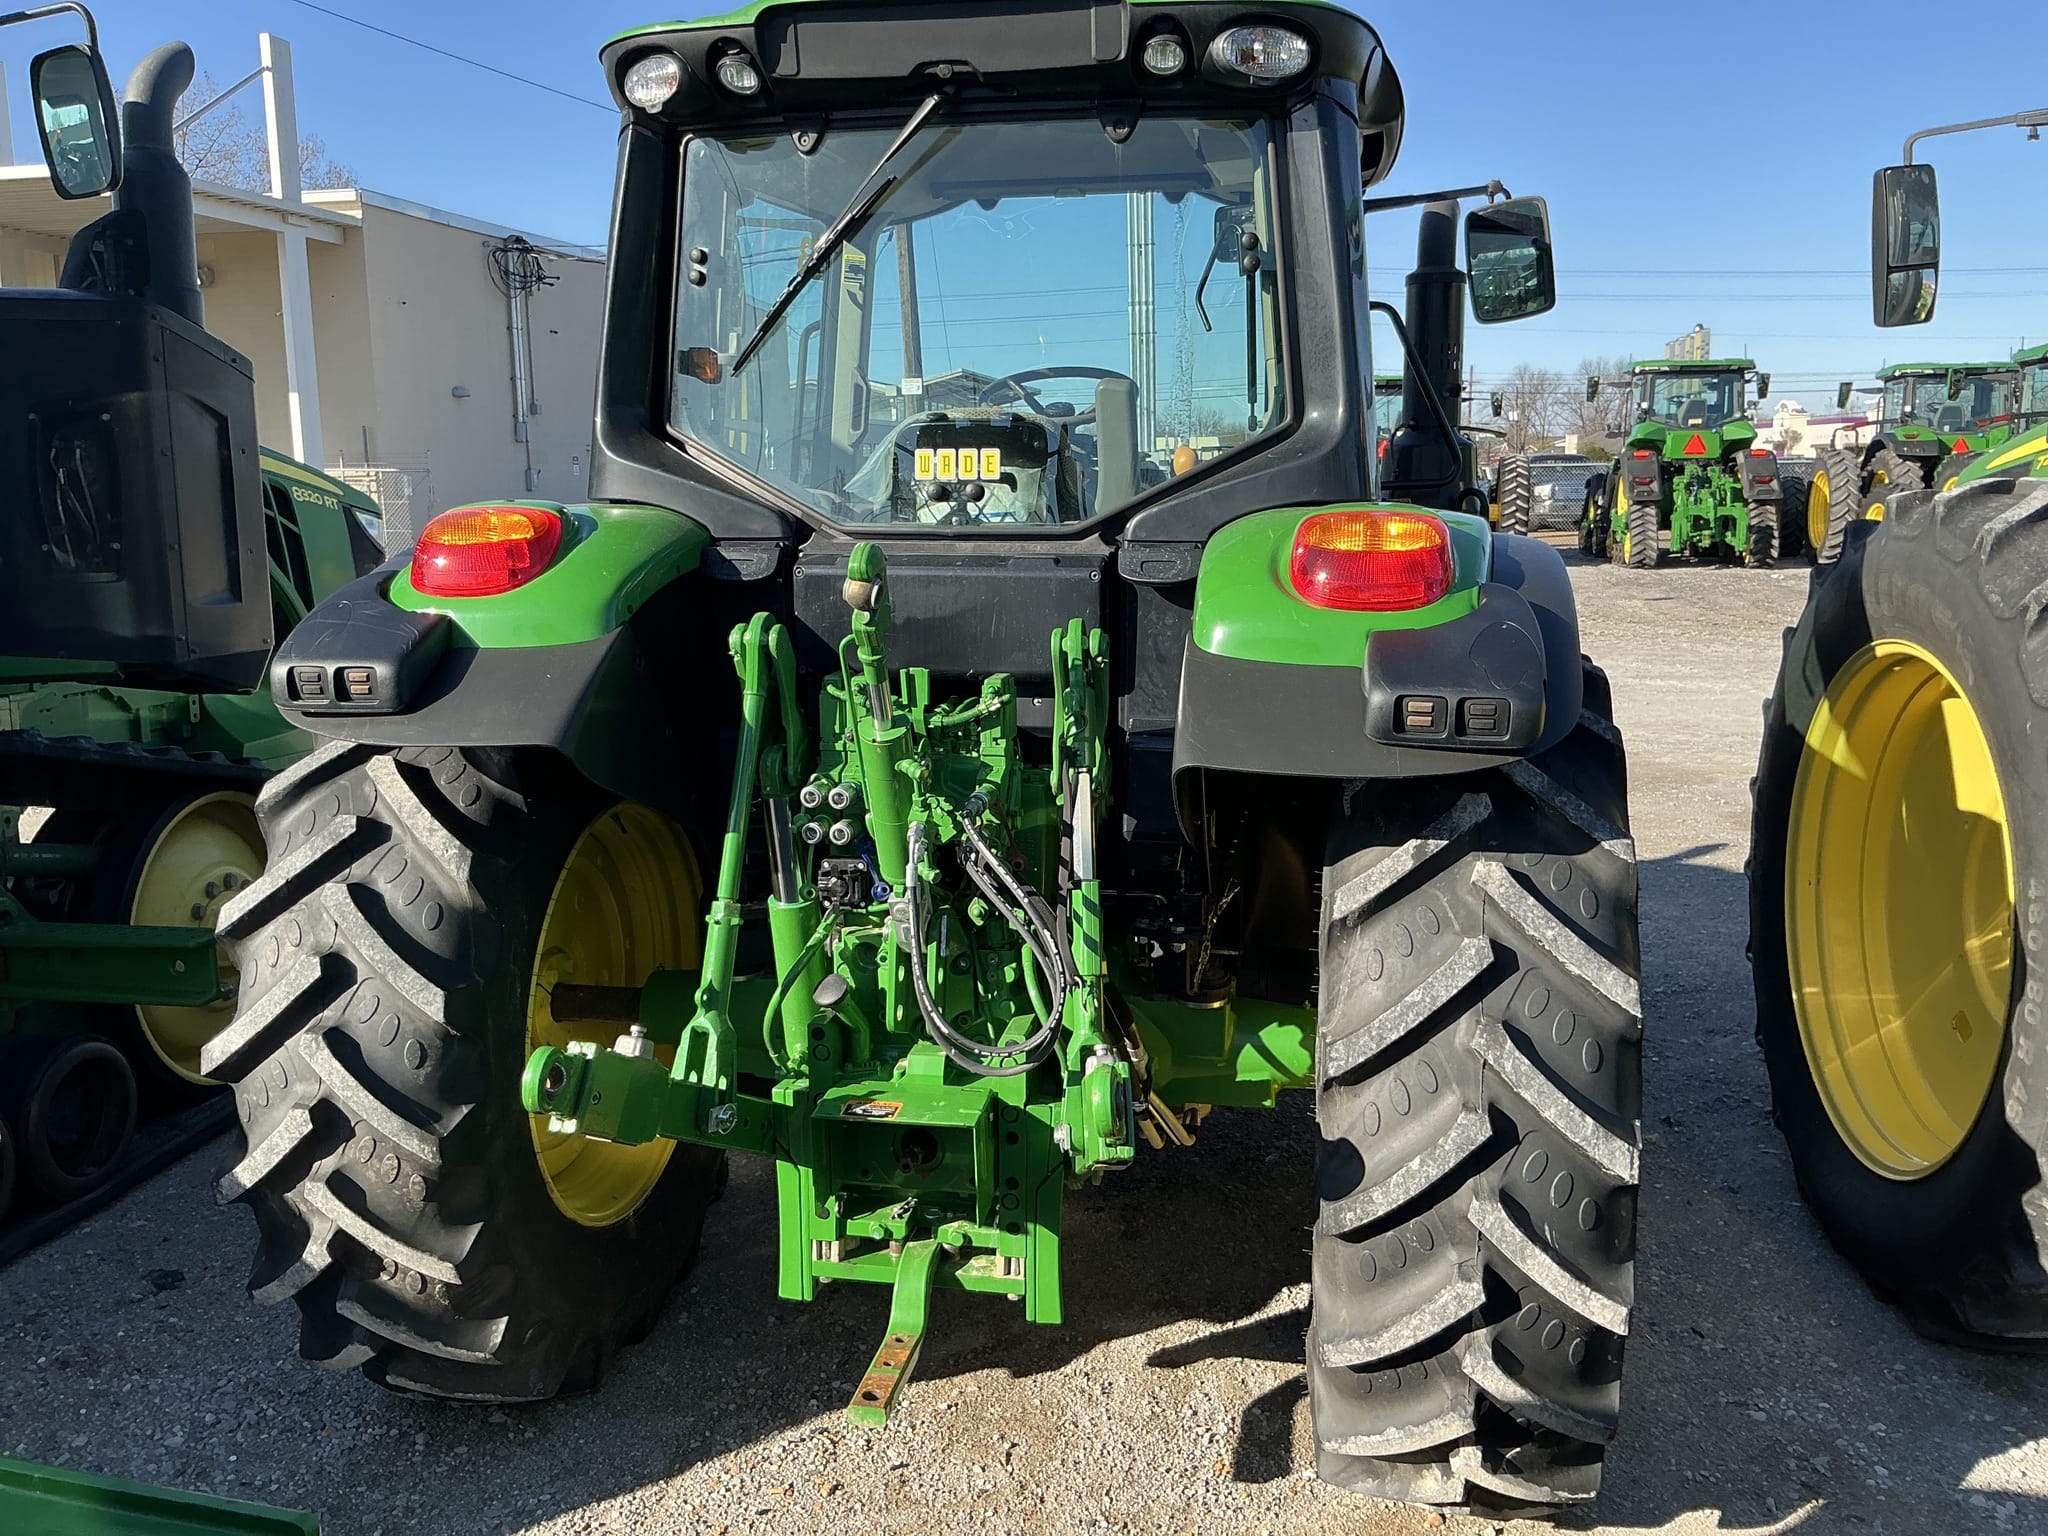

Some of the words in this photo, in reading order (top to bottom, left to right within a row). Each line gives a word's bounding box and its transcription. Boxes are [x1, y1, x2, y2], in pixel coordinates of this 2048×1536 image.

[918, 453, 997, 475] WADE
[292, 486, 323, 505] 8320
[324, 496, 338, 510] RT
